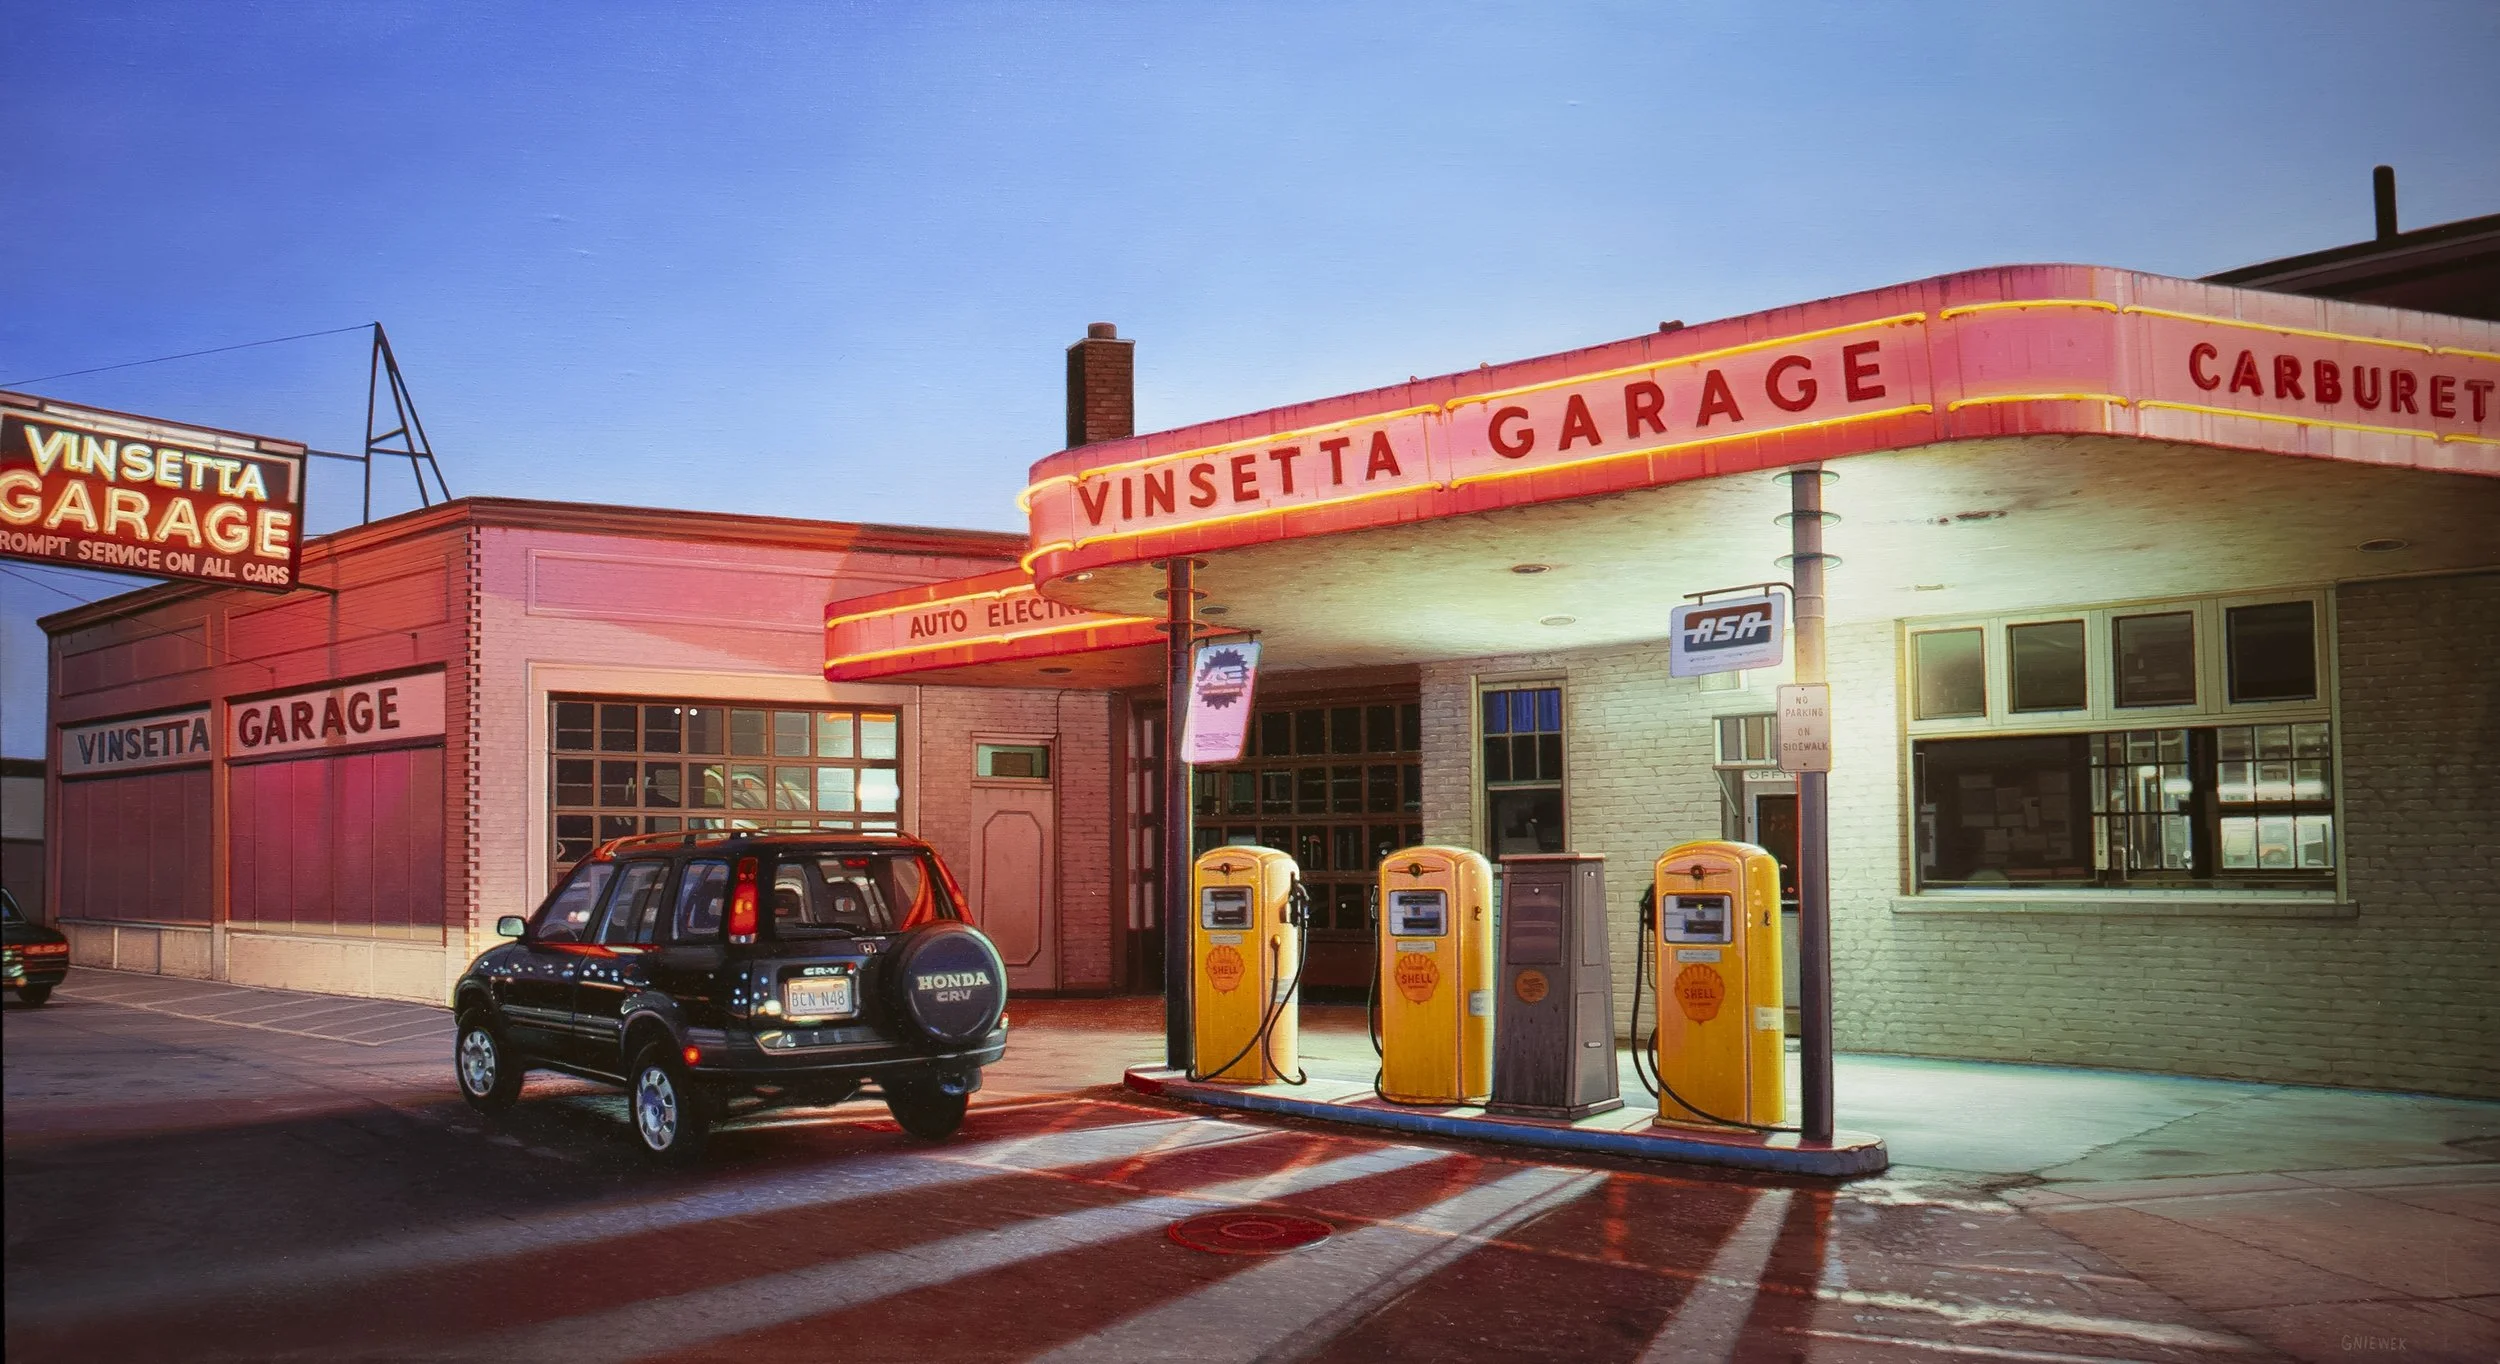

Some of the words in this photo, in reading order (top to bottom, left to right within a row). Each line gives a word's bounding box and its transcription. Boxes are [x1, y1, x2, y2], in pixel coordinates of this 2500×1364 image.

[2188, 342, 2495, 422] CARBURET
[1078, 430, 1401, 526] VINSETTA
[1488, 340, 1886, 459] GARAGE
[24, 424, 269, 501] VINSETTA
[0, 469, 292, 560] GARAGE
[78, 539, 161, 570] SERVICE
[166, 552, 195, 573] ON
[202, 557, 236, 578] ALL
[242, 562, 289, 585] CARS
[910, 608, 968, 639] AUTO
[1795, 696, 1809, 705] NO
[238, 687, 400, 748] GARAGE
[1785, 708, 1824, 717] PARKING
[1797, 727, 1810, 736] ON
[77, 717, 211, 765] VINSETTA
[1783, 742, 1828, 751] SIDEWALK
[1212, 965, 1239, 975] SHELL
[1401, 973, 1432, 984] SHELL
[916, 971, 990, 991] HONDA
[791, 991, 816, 1007] BCN
[821, 990, 845, 1006] N48
[1683, 988, 1717, 999] SHELL
[2341, 1334, 2408, 1351] GNIEWEK
